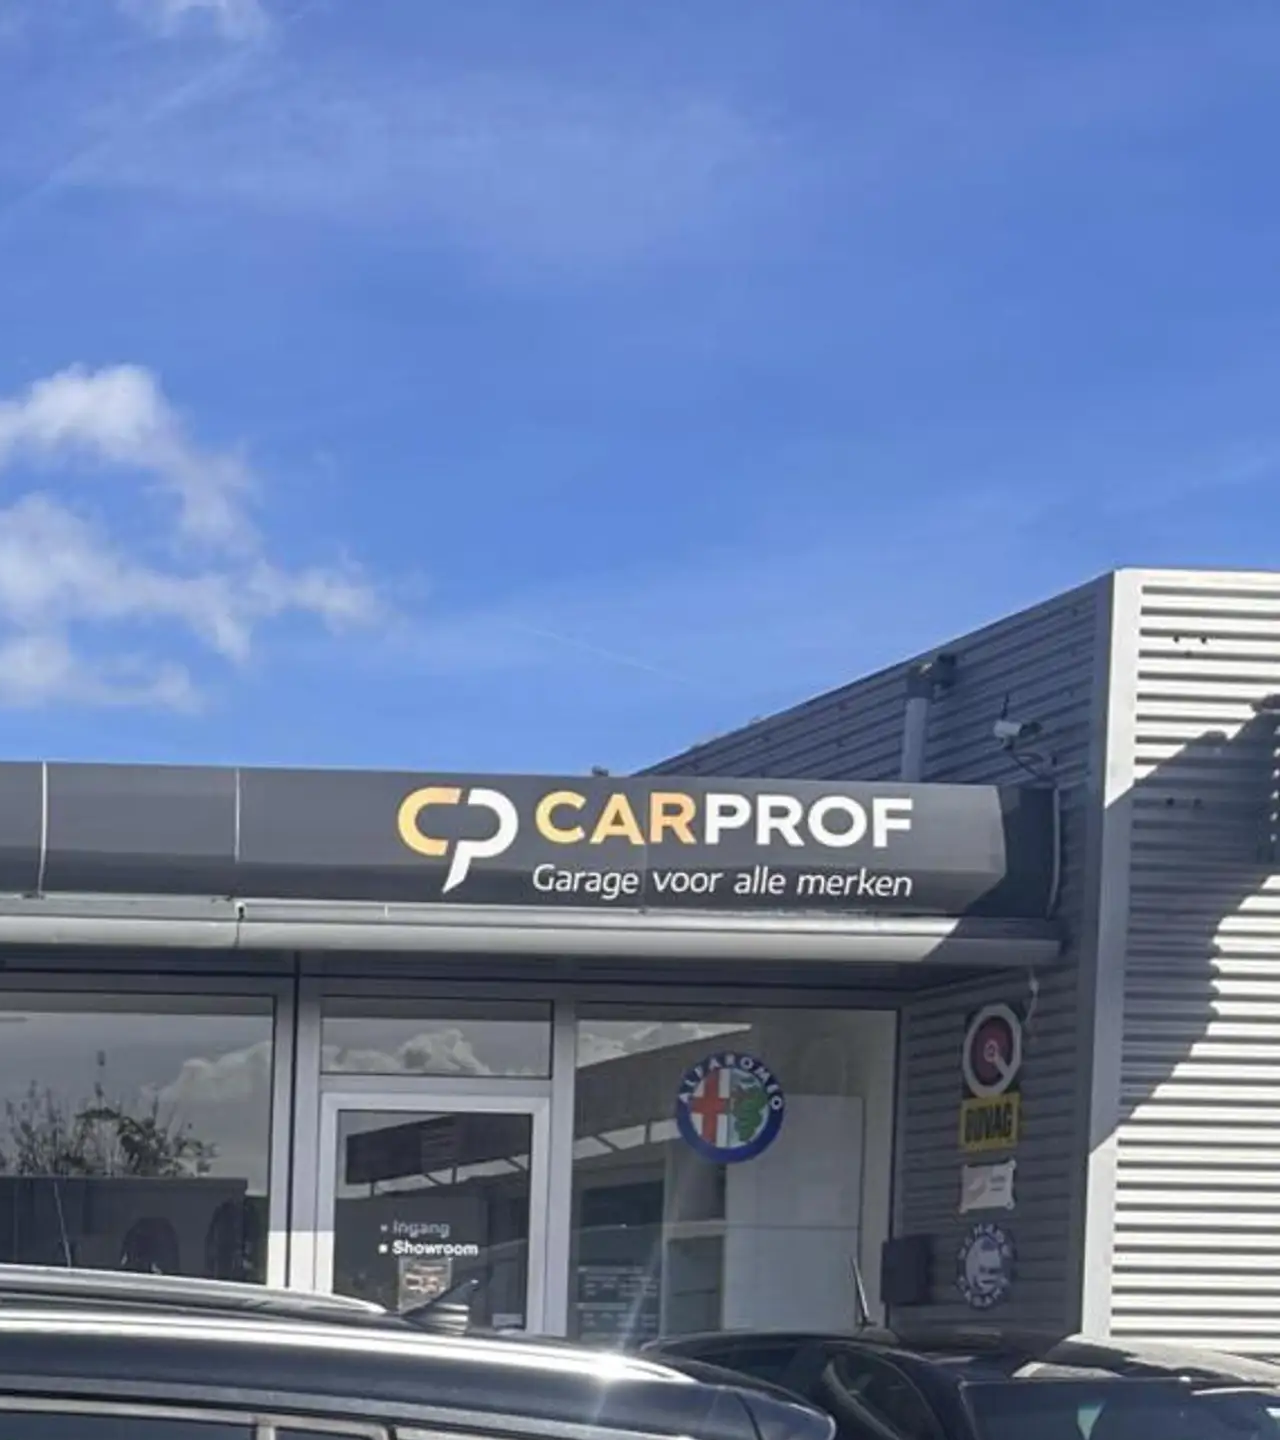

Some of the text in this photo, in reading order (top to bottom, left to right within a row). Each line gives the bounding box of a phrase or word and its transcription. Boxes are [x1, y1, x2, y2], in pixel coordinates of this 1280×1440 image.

[535, 790, 914, 849] CARPROF
[533, 862, 913, 901] Garage voor alle merken
[392, 1219, 450, 1239] Ingang
[391, 1239, 479, 1257] Showroom
